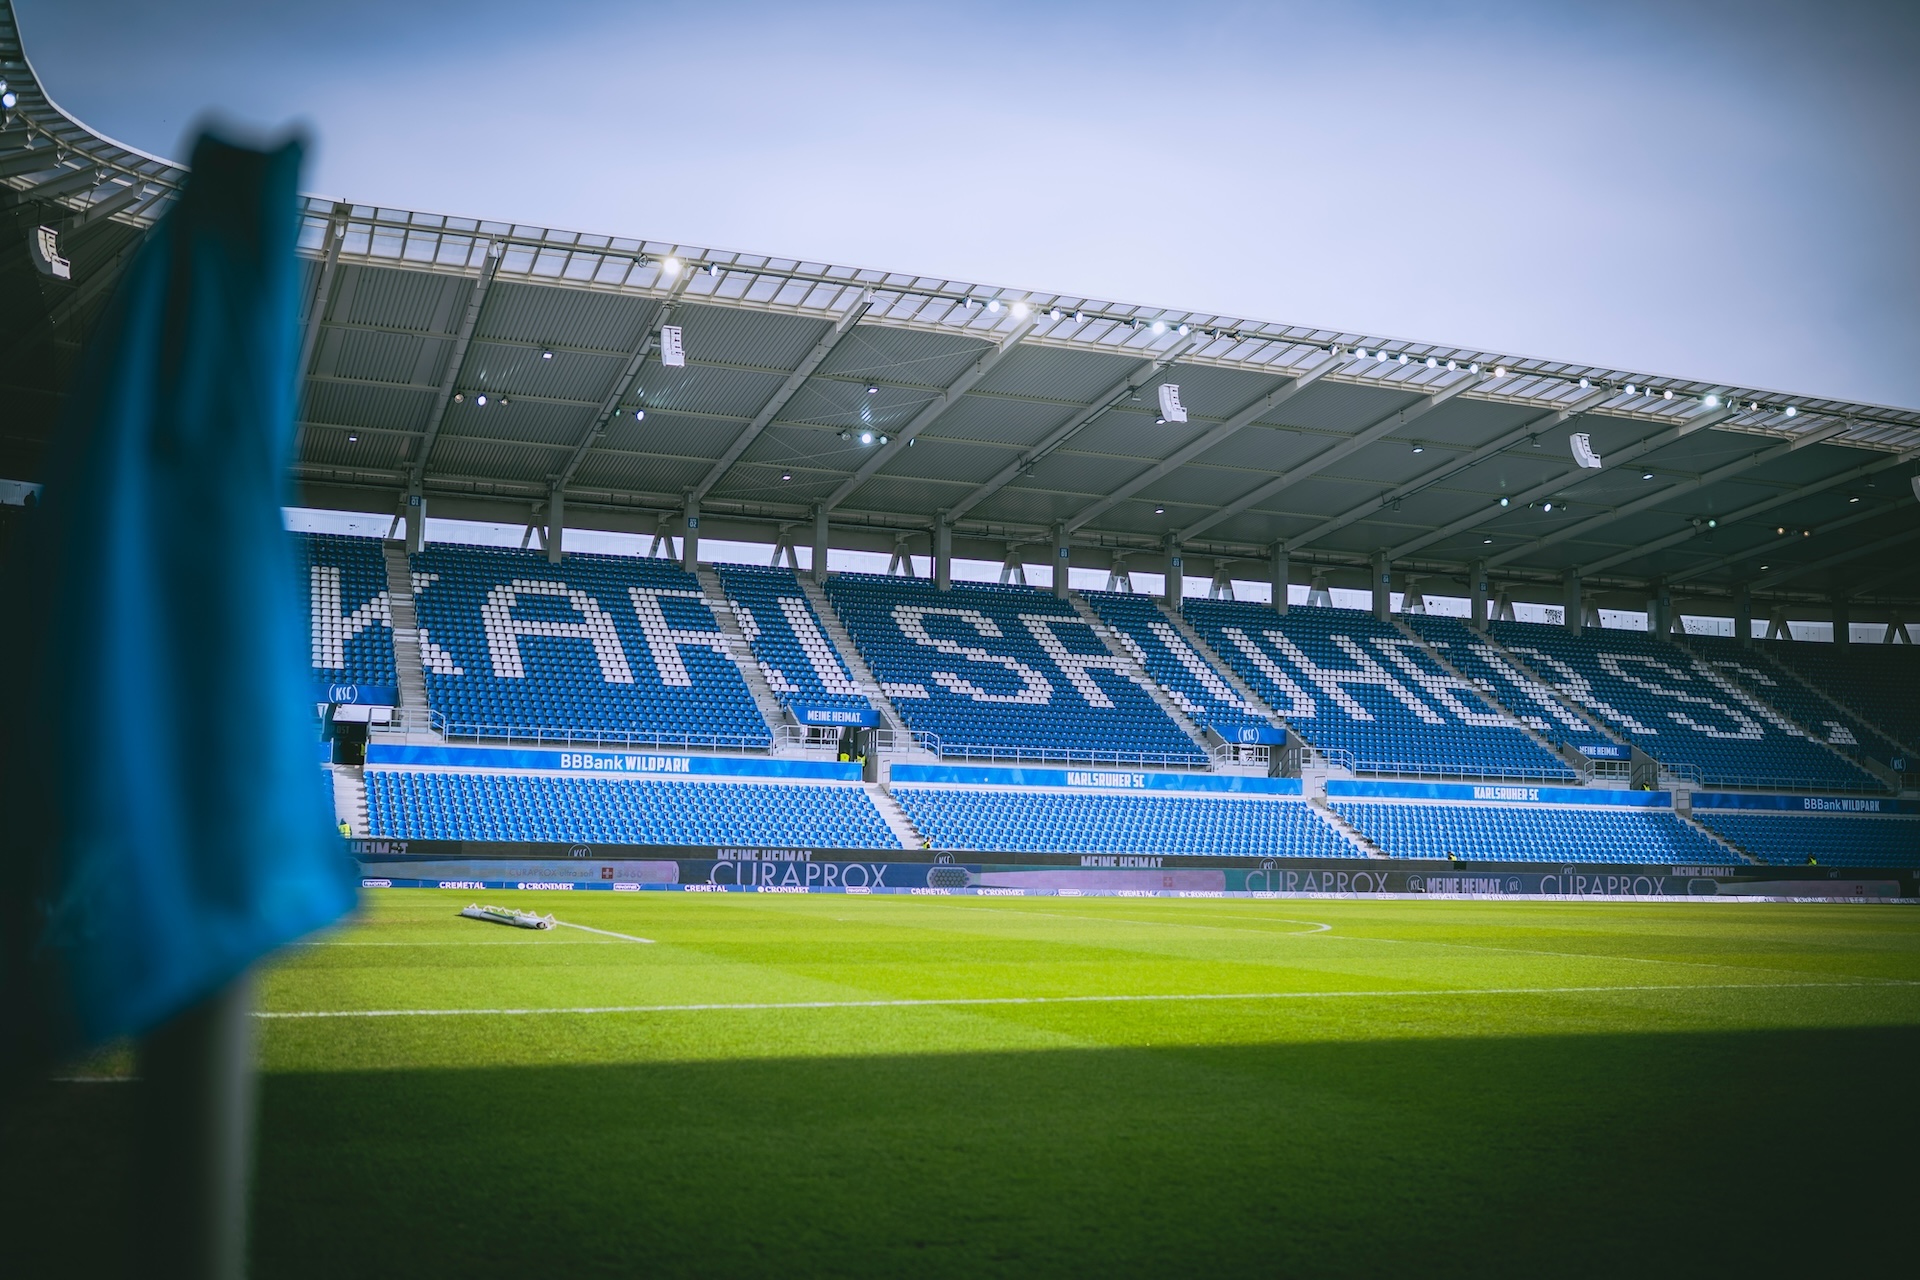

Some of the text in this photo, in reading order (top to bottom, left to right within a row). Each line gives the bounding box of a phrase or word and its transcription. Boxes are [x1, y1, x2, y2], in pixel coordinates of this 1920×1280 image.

[336, 687, 351, 700] KSC
[807, 710, 862, 723] MEINE HEIMAT.
[1243, 729, 1254, 741] KSC
[1579, 746, 1596, 755] MEINE
[561, 753, 690, 772] BBBank WILDPARK
[1067, 772, 1145, 788] KARLSRUHER SC
[1473, 786, 1539, 801] KARLSRUHER SC
[1804, 798, 1880, 812] BBBank WILDPARK
[710, 861, 888, 888] CURAPROX
[1245, 871, 1389, 893] CURAPROX
[526, 882, 574, 890] CRONIMET
[1426, 878, 1461, 893] MEINE
[1540, 875, 1665, 896] CURAPROX
